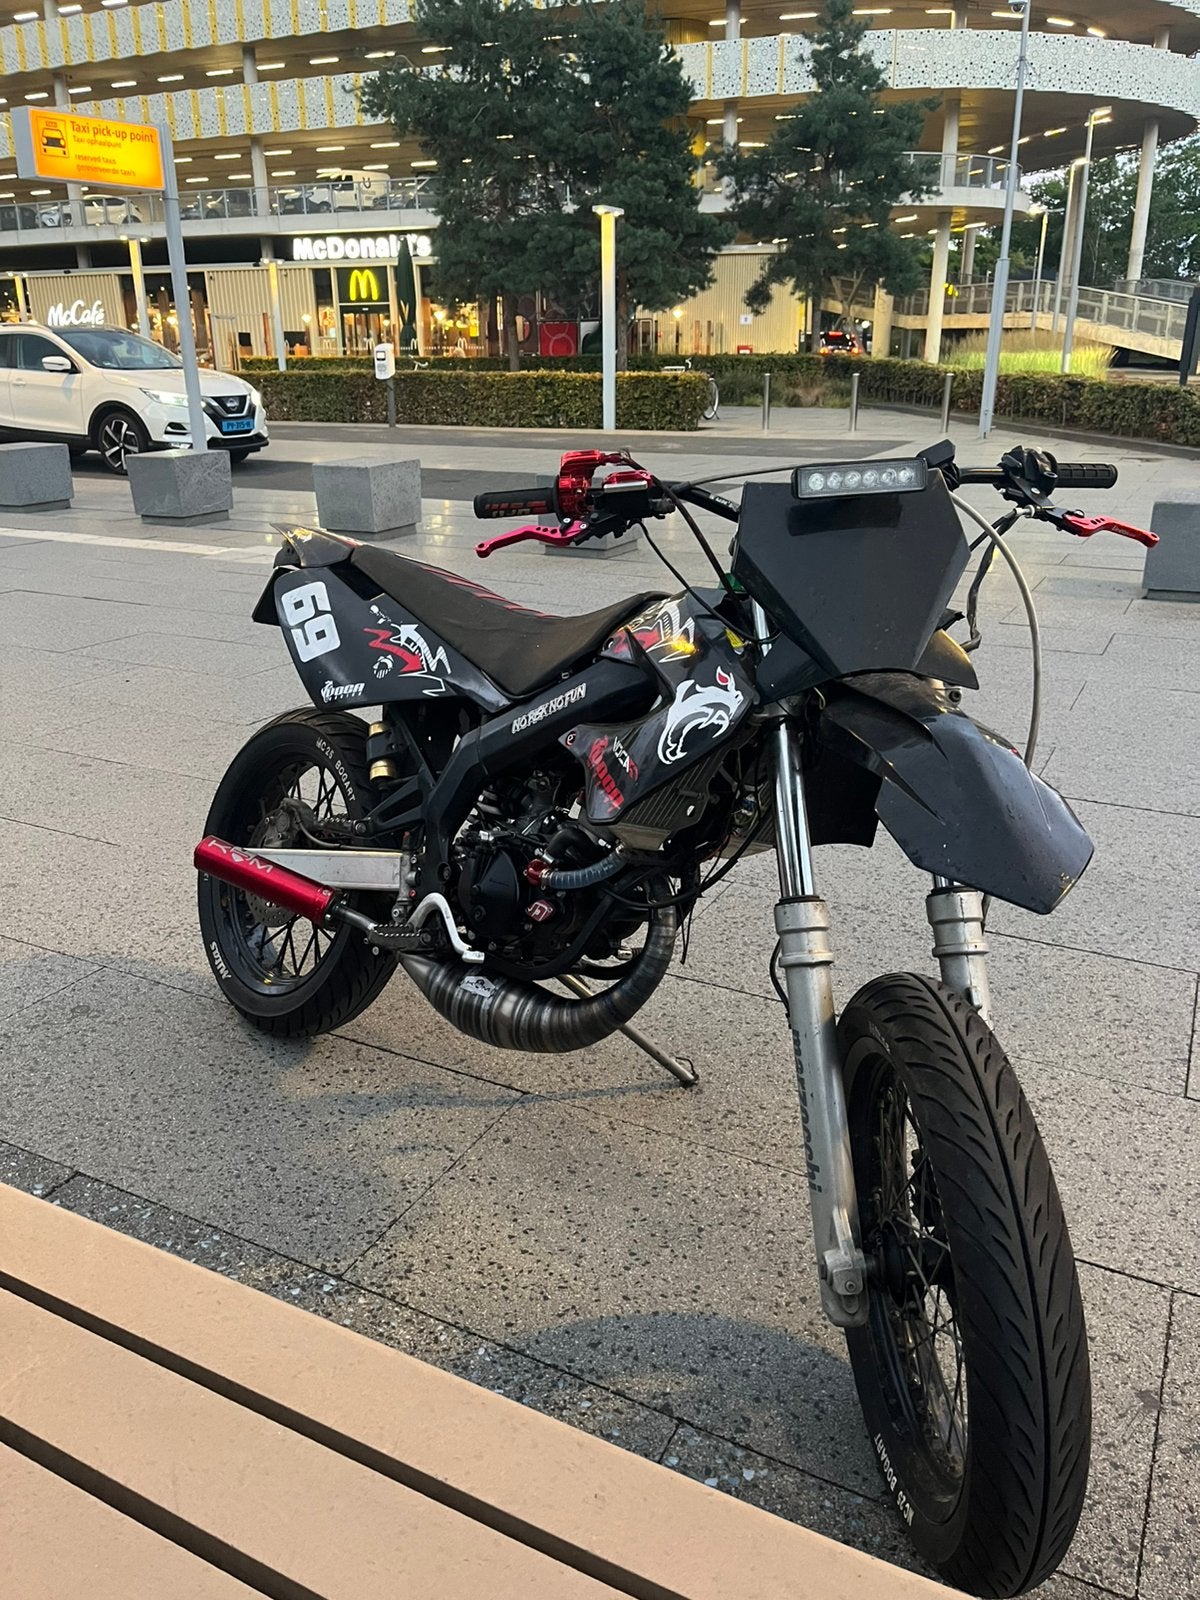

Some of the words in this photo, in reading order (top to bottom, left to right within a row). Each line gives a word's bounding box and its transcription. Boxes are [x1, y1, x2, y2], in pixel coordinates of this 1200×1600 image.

[70, 120, 90, 133] Taxi
[93, 124, 127, 140] pick-up
[130, 130, 154, 144] point
[281, 581, 341, 663] 69
[511, 714, 528, 734] NO
[548, 694, 564, 715] NO
[562, 682, 587, 708] FUN
[334, 759, 356, 801] BOGART
[873, 1432, 898, 1492] BOGART
